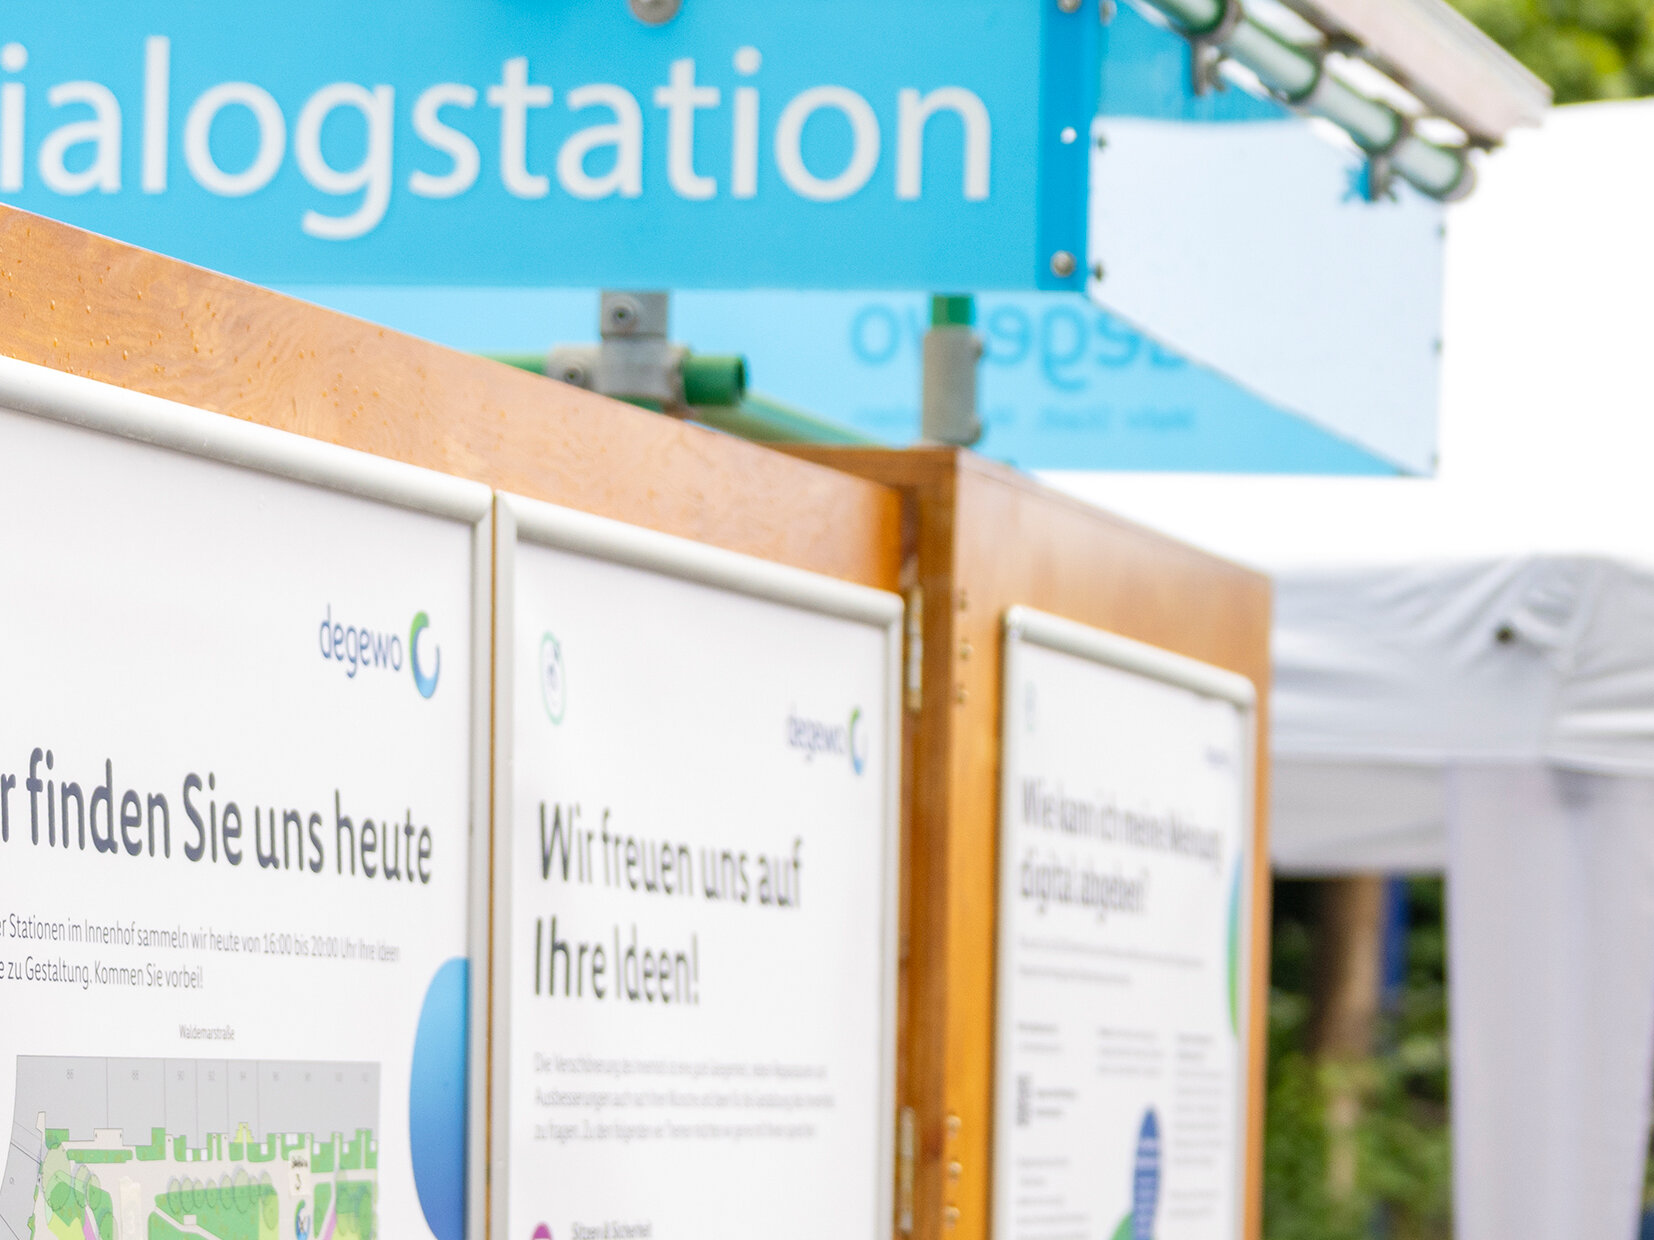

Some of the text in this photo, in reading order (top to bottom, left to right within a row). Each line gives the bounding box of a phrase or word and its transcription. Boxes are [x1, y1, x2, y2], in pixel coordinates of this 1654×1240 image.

[0, 36, 990, 240] ialogstation
[318, 603, 402, 678] degewo
[0, 747, 433, 885] r finden Sie uns heute
[538, 801, 805, 908] Wir freuen uns auf
[0, 918, 7, 937] r
[9, 912, 66, 942] Stationen
[68, 917, 83, 942] im
[85, 919, 137, 945] Innenhof
[137, 924, 189, 949] sammeln
[190, 926, 208, 949] wir
[209, 927, 240, 952] heute
[241, 935, 261, 953] von
[263, 932, 292, 955] 16:00
[294, 932, 310, 956] bis
[7, 961, 22, 981] zu
[25, 955, 93, 990] Gestaltung.
[94, 960, 143, 986] Kommen
[146, 962, 163, 987] Sie
[164, 964, 204, 989] vorbei!
[535, 915, 700, 1006] Ihre Ideen!
[178, 1023, 236, 1040] Waldemarstraße
